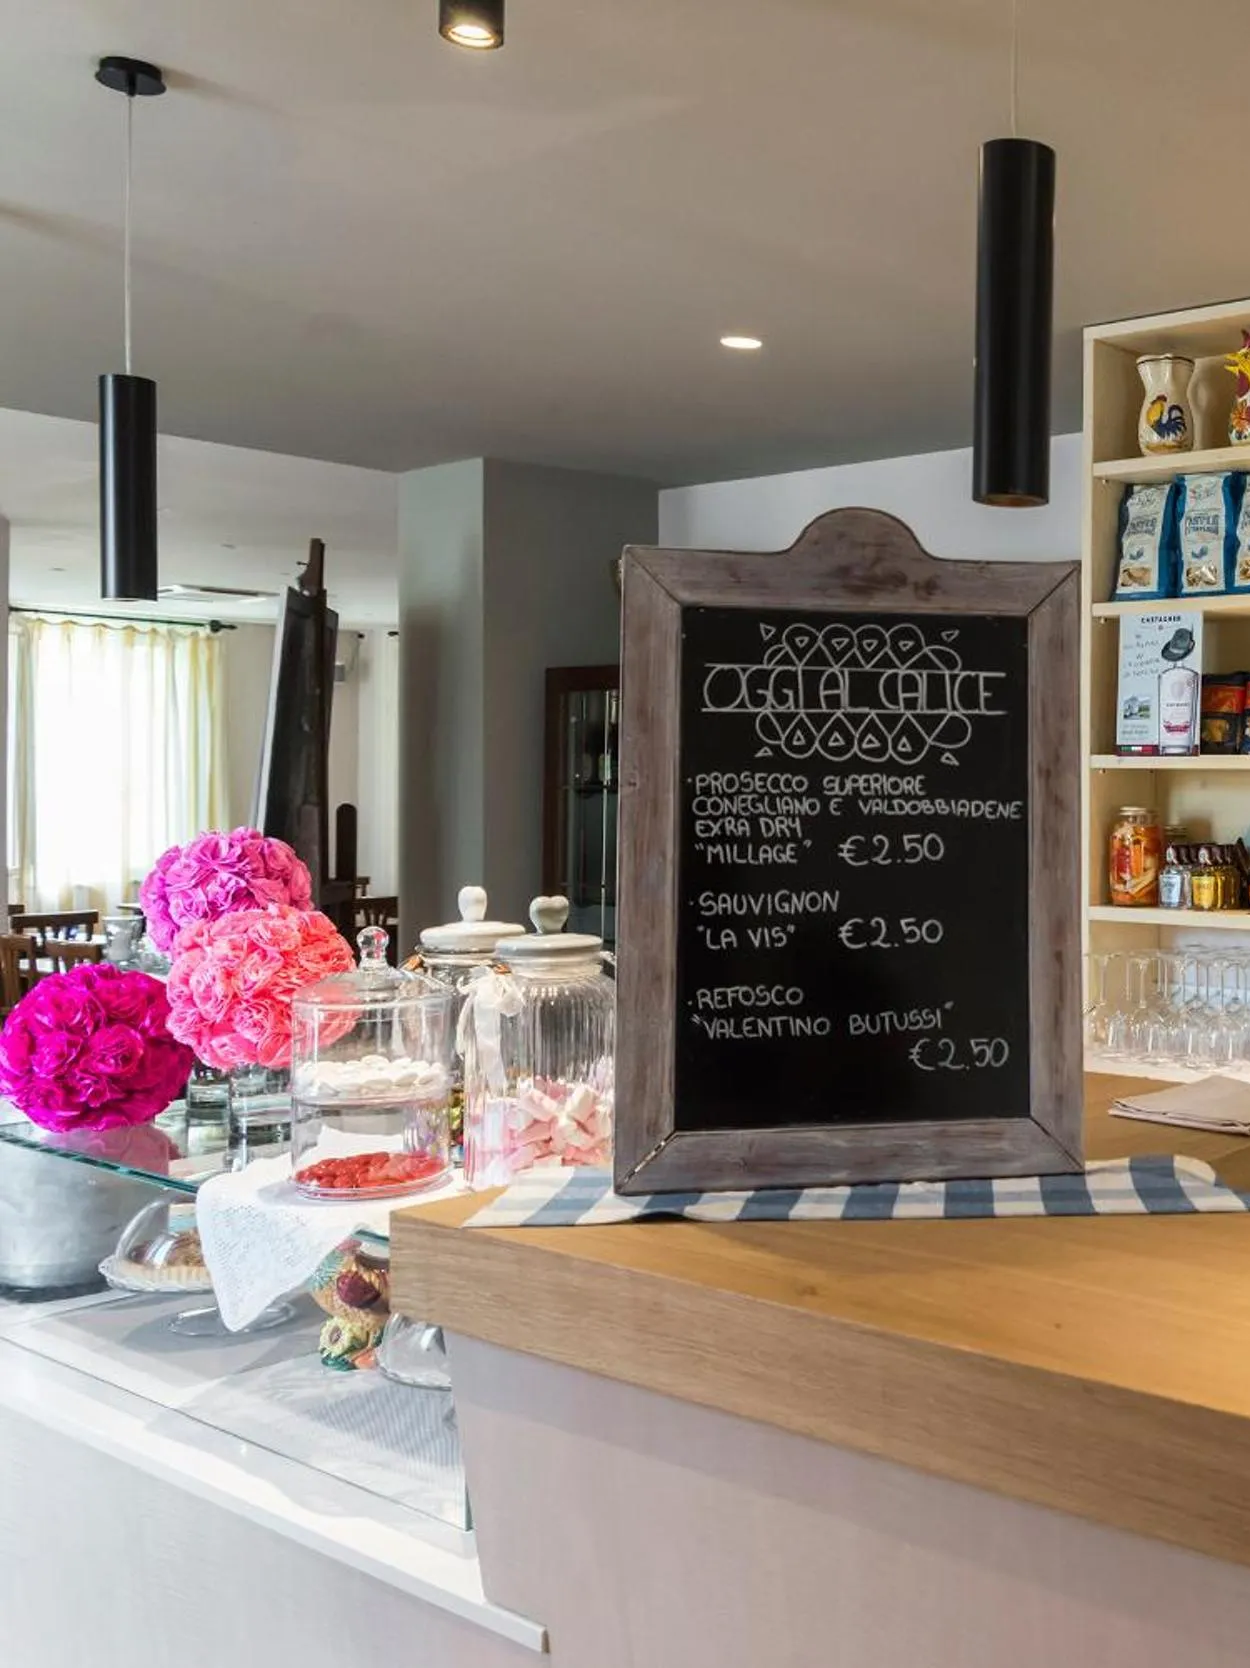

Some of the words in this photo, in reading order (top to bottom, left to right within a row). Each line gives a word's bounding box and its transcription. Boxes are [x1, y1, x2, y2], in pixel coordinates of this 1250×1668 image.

[703, 665, 804, 712] OGGI
[820, 668, 869, 713] AL
[879, 669, 1006, 714] CALICE
[696, 772, 809, 796] PROSECCO
[823, 774, 926, 797] SUPERIORE
[692, 797, 820, 816] CONEGLIANO
[829, 799, 843, 816] E
[859, 799, 1023, 819] VALDOBBIADENE
[695, 818, 750, 838] EXRA
[760, 817, 802, 839] DRY
[838, 833, 945, 866] €2.50
[699, 889, 839, 916] SAUVIGNON
[838, 917, 944, 949] €2.50
[696, 985, 804, 1010] REFOSCO
[908, 1038, 1010, 1070] €2.50
